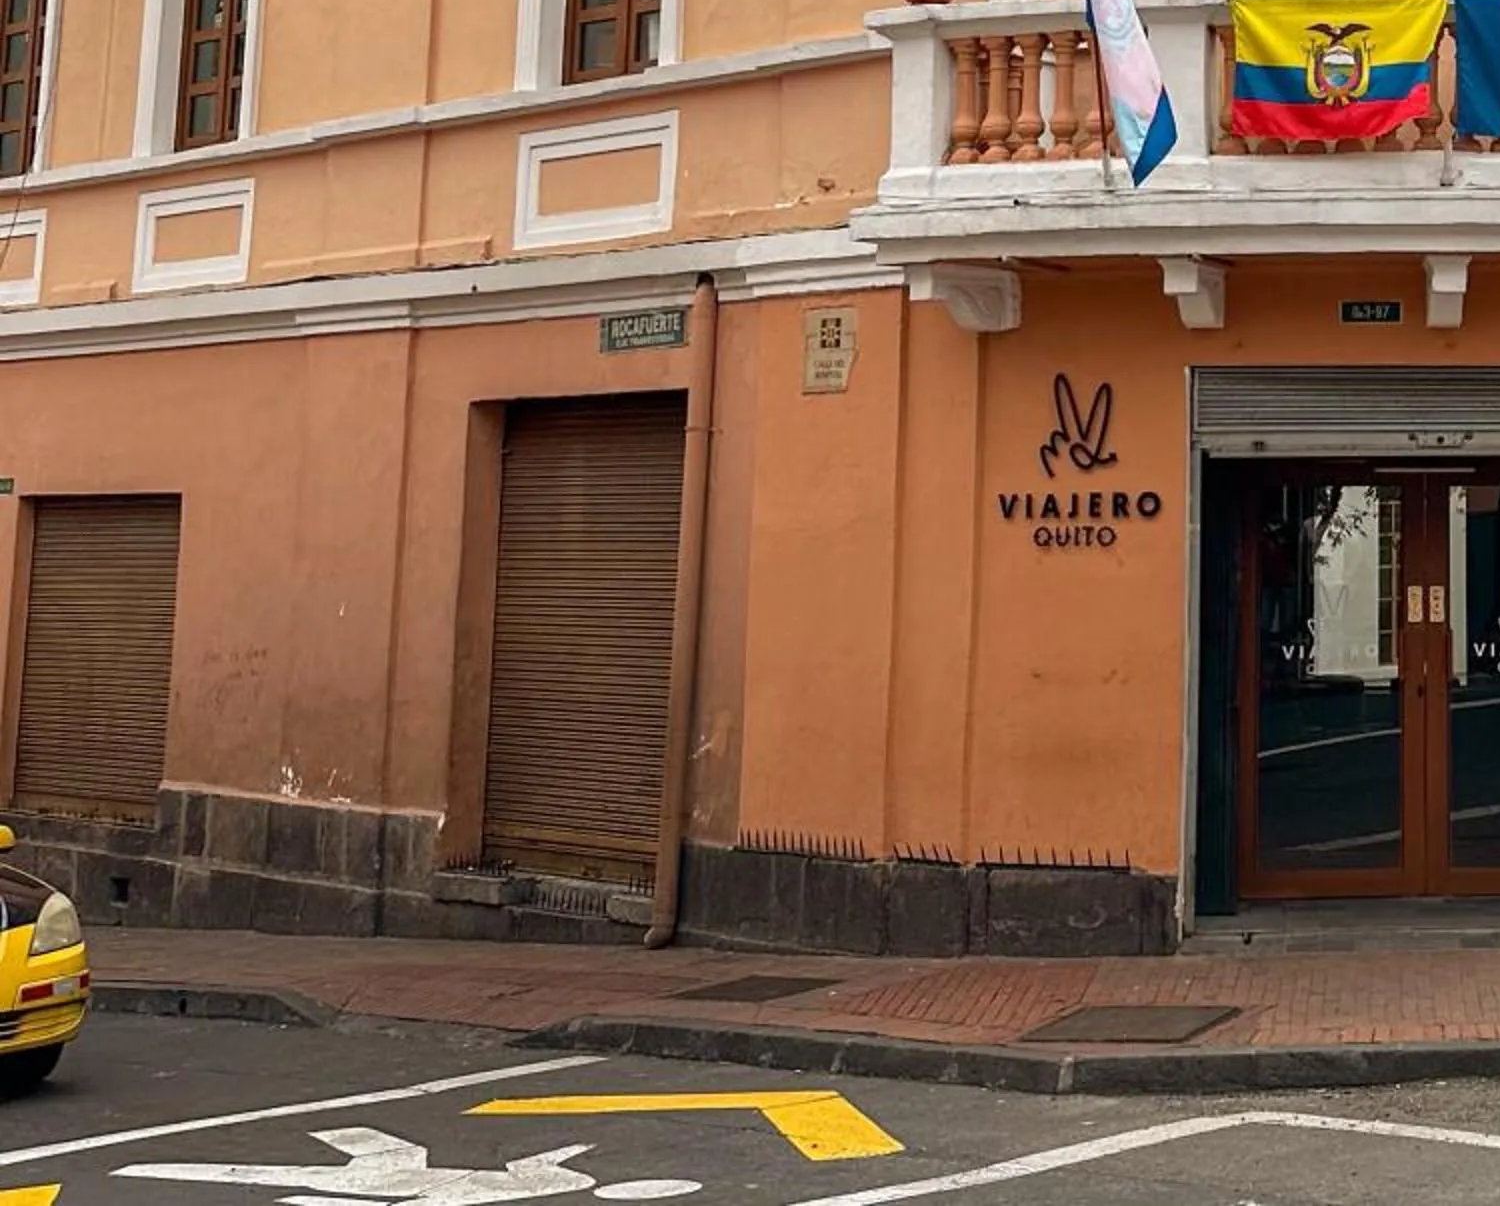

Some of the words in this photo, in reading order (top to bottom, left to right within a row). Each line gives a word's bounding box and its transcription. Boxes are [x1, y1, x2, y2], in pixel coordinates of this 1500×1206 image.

[611, 313, 681, 339] ROCAFUERTE
[998, 491, 1163, 521] VIAJERO
[1033, 526, 1117, 548] QUITO
